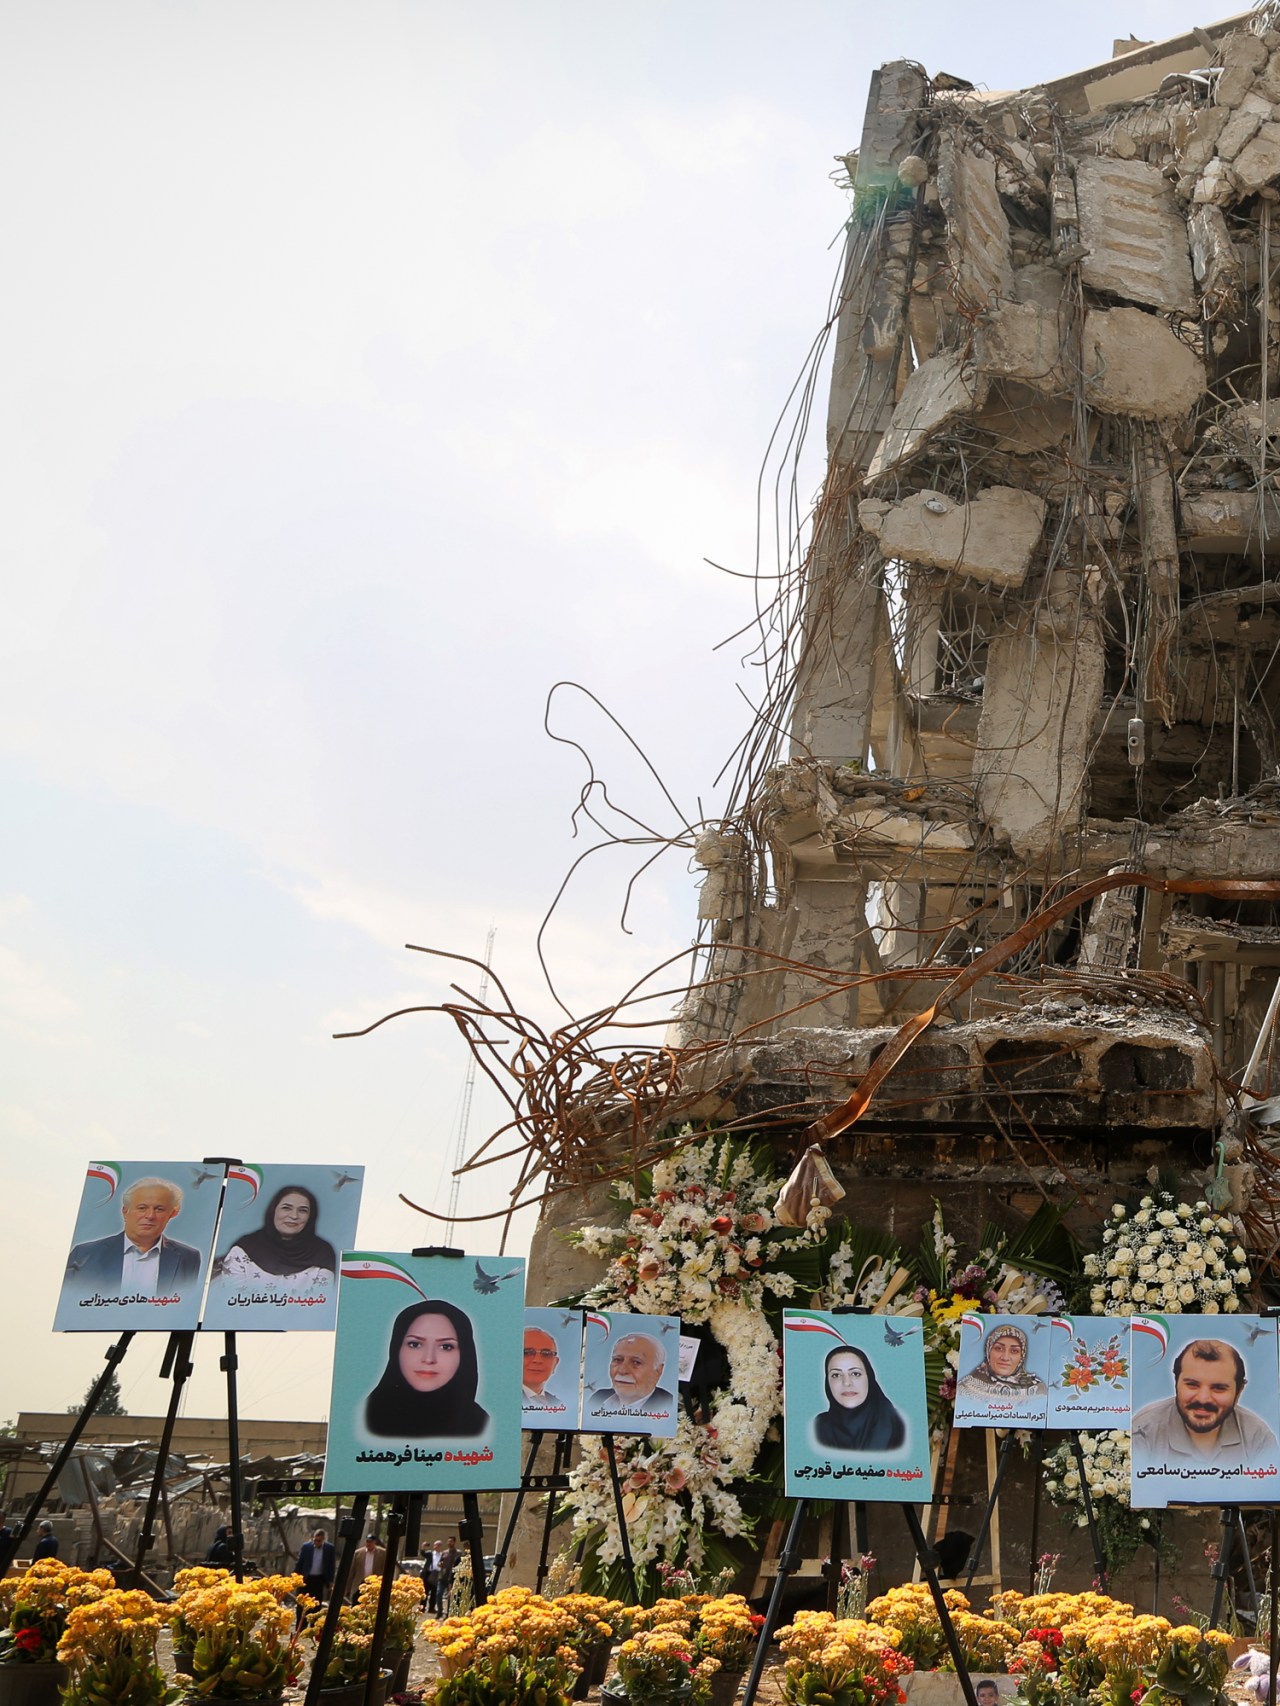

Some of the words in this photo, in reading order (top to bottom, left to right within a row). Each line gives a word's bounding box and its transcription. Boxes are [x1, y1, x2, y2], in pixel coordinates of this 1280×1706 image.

[79, 1293, 119, 1307] میرزایی
[118, 1293, 148, 1306] هادی
[148, 1293, 180, 1306] شهید
[227, 1293, 268, 1306] غفاریان
[269, 1293, 288, 1306] ژیلا
[288, 1293, 326, 1306] شهیده
[543, 1404, 567, 1414] شهید
[591, 1407, 618, 1418] میرزایی
[988, 1402, 1013, 1411] شهیده
[1055, 1404, 1088, 1413] محمودی
[1105, 1404, 1131, 1413] شهیده
[647, 1410, 669, 1420] شهید
[1031, 1412, 1046, 1421] اکرم
[355, 1444, 412, 1466] فرهمند
[413, 1447, 443, 1466] مینا
[444, 1446, 494, 1465] شهیده
[794, 1461, 832, 1480] قورچی
[832, 1464, 854, 1479] علی
[855, 1465, 886, 1480] صفیه
[886, 1466, 923, 1481] شهیده
[1136, 1464, 1180, 1478] سامعی
[1243, 1464, 1278, 1478] شهید
